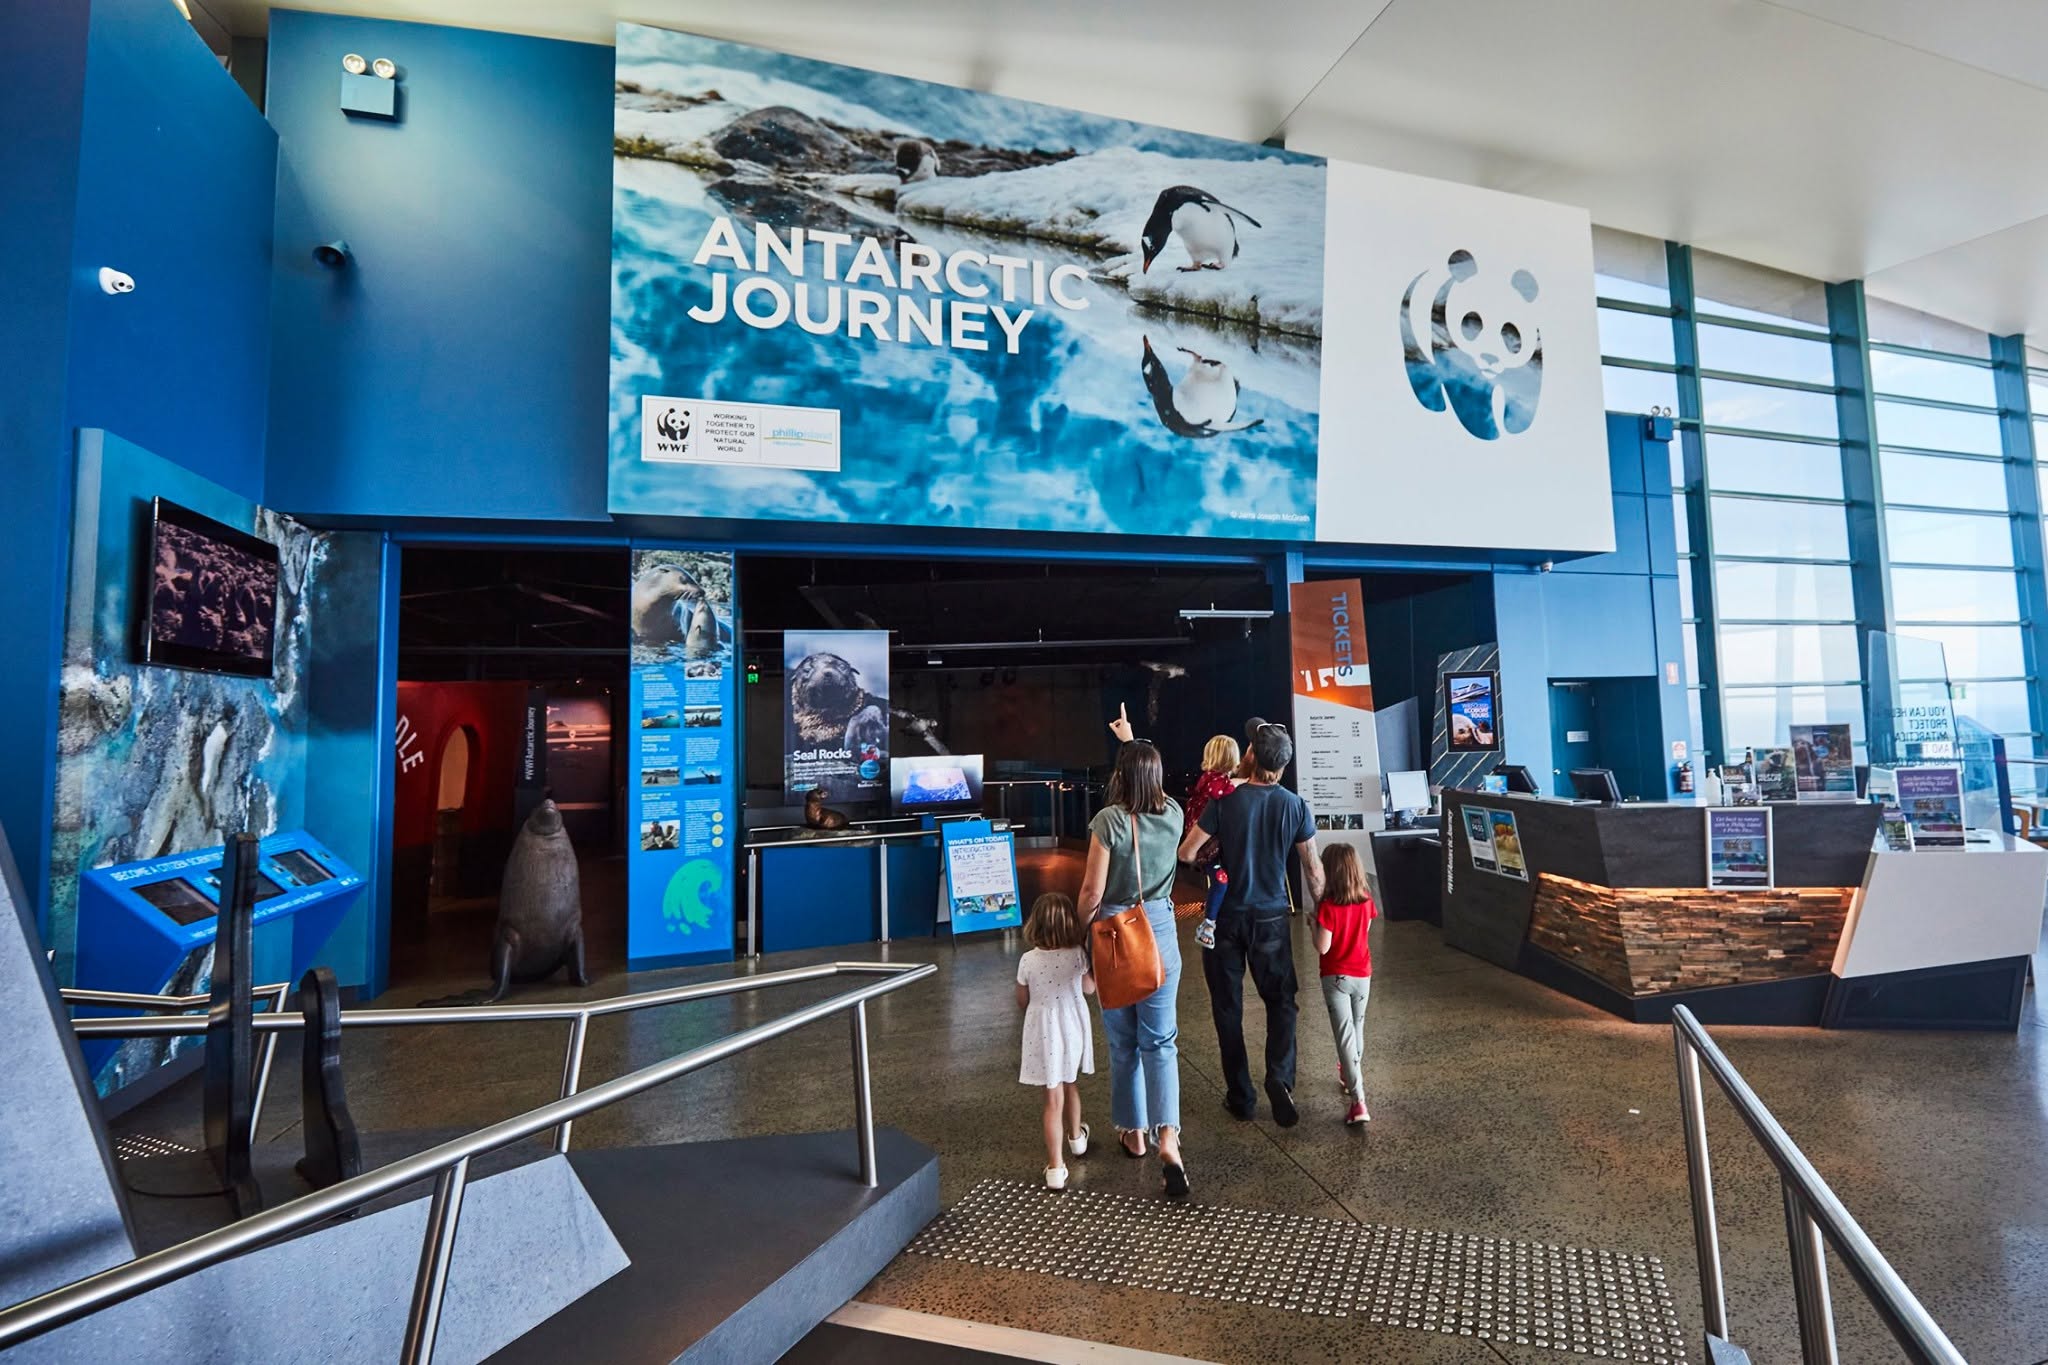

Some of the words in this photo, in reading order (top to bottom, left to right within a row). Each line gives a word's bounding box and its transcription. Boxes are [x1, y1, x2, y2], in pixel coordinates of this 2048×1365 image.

[692, 215, 1092, 312] ANTARCTIC
[686, 271, 1035, 356] JOURNEY
[713, 413, 748, 421] WORKING
[705, 420, 744, 429] TOGETHER
[705, 428, 738, 436] PROTECT
[713, 437, 747, 445] NATURAL
[657, 442, 689, 453] WWF
[717, 445, 744, 453] WORLD
[1281, 513, 1310, 522] McGrath
[1331, 591, 1353, 677] TICKETS
[793, 749, 817, 761] Seal
[818, 747, 853, 760] Rocks
[947, 838, 973, 846] WHAT'S
[109, 867, 152, 882] BECOME
